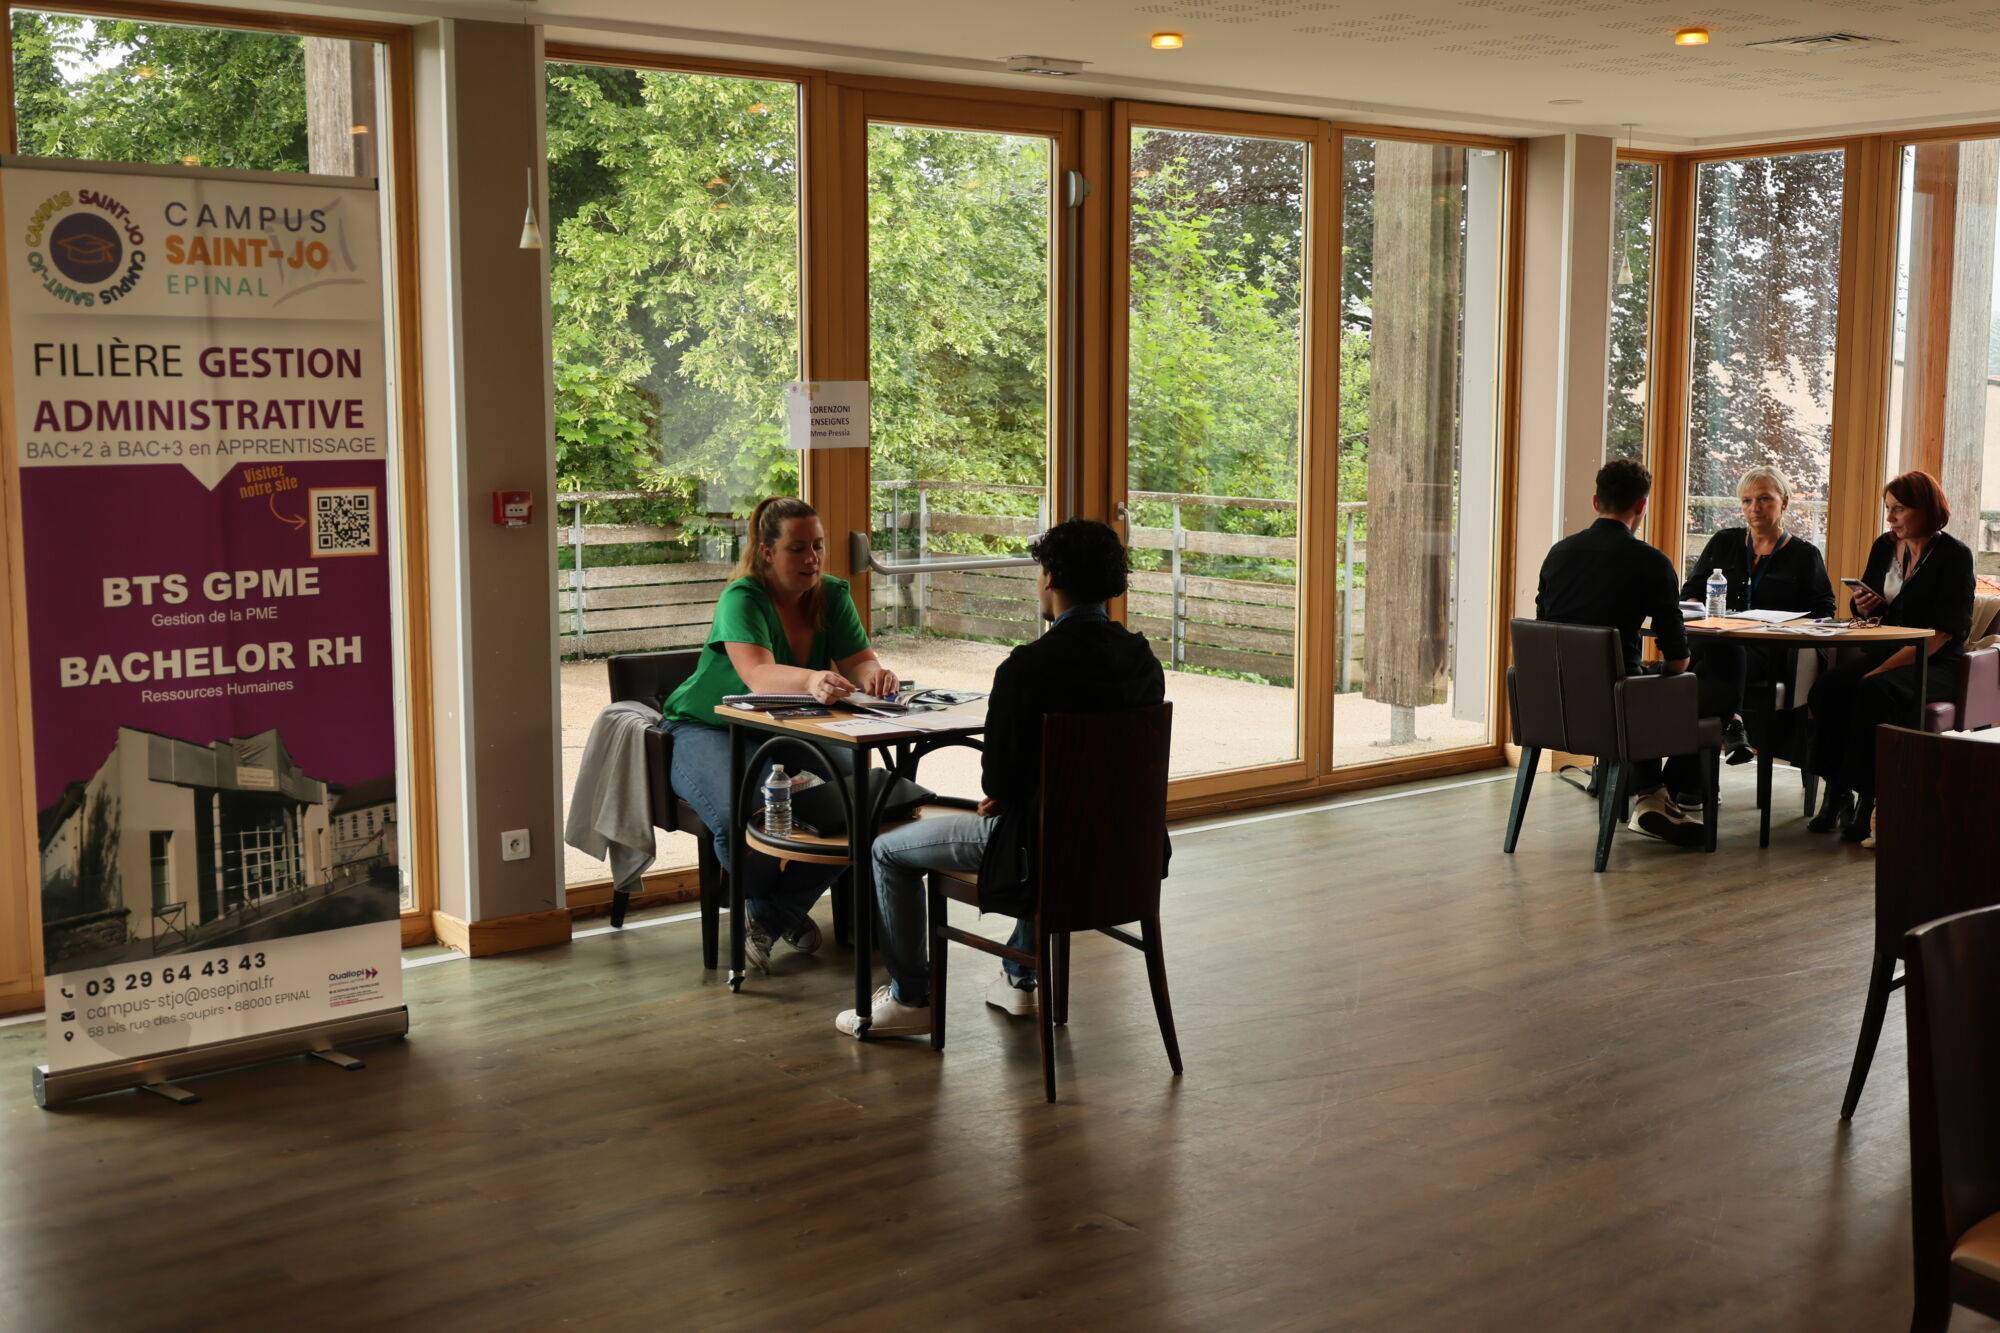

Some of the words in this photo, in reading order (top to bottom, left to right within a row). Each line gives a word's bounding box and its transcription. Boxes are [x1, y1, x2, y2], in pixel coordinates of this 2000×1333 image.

[25, 191, 73, 248] CAMPUS
[79, 189, 144, 246] SAINT-JO
[165, 201, 327, 234] CAMPUS
[165, 234, 330, 271] SAINT-JO
[99, 250, 146, 305] CAMPUS
[167, 274, 269, 297] EPINAL
[34, 337, 183, 377] FILIÈRE
[199, 347, 362, 379] GESTION
[33, 399, 365, 433] ADMINISTRATIVE
[809, 405, 851, 414] LORENZONI
[811, 417, 850, 426] ENSEIGNES
[27, 441, 94, 459] BAC+2
[101, 441, 112, 458] à
[118, 440, 183, 457] BAC+3
[189, 442, 211, 456] en
[215, 437, 376, 456] APPRENTISSAGE
[240, 481, 273, 499] notre
[274, 475, 298, 492] site
[243, 464, 285, 483] Visitez
[103, 574, 189, 608] BTS
[203, 566, 320, 602] GPME
[151, 611, 205, 627] Gestion
[209, 609, 226, 624] de
[230, 608, 242, 622] la
[246, 606, 278, 622] PME
[60, 641, 295, 688] BACHELOR
[308, 635, 362, 668] RH
[142, 682, 223, 703] Ressources
[227, 679, 294, 697] Humaines
[86, 977, 116, 997] 03
[125, 971, 152, 990] 29
[162, 965, 191, 984] 64
[201, 958, 229, 977] 43
[239, 952, 266, 971] 43
[86, 974, 274, 1020] campus-stjo@esepinal.fr
[88, 1026, 104, 1038] 58
[107, 1022, 127, 1035] bis
[129, 1018, 150, 1032] rue
[153, 1013, 177, 1026] des
[179, 1005, 225, 1025] soupirs
[234, 995, 272, 1012] 88000
[275, 989, 311, 1004] EPINAL
